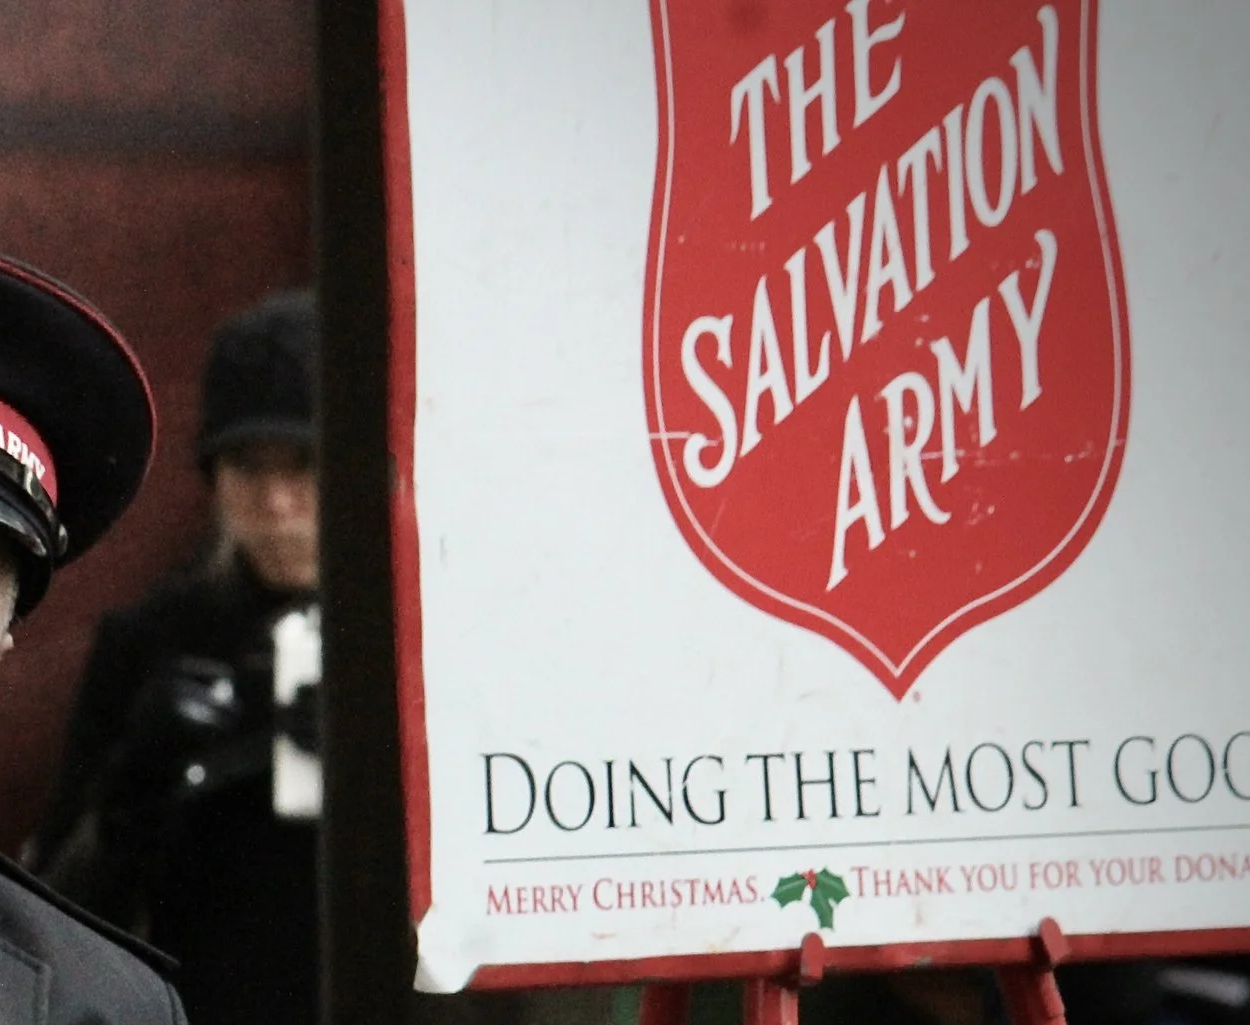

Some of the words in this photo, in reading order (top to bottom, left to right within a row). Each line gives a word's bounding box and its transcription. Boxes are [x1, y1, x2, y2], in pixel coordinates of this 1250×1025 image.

[730, 0, 906, 221] THE
[680, 5, 1064, 488] SALVATION
[826, 230, 1057, 592] ARMY
[483, 751, 729, 835] DOING
[745, 749, 881, 822] THE
[904, 739, 1091, 816] MOST
[485, 884, 583, 916] MERRY
[593, 876, 764, 911] CHRISTMAS.
[851, 866, 955, 898] THANK
[960, 863, 1019, 893] YOU
[1028, 859, 1083, 890] FOR
[1090, 855, 1166, 887] YOUR
